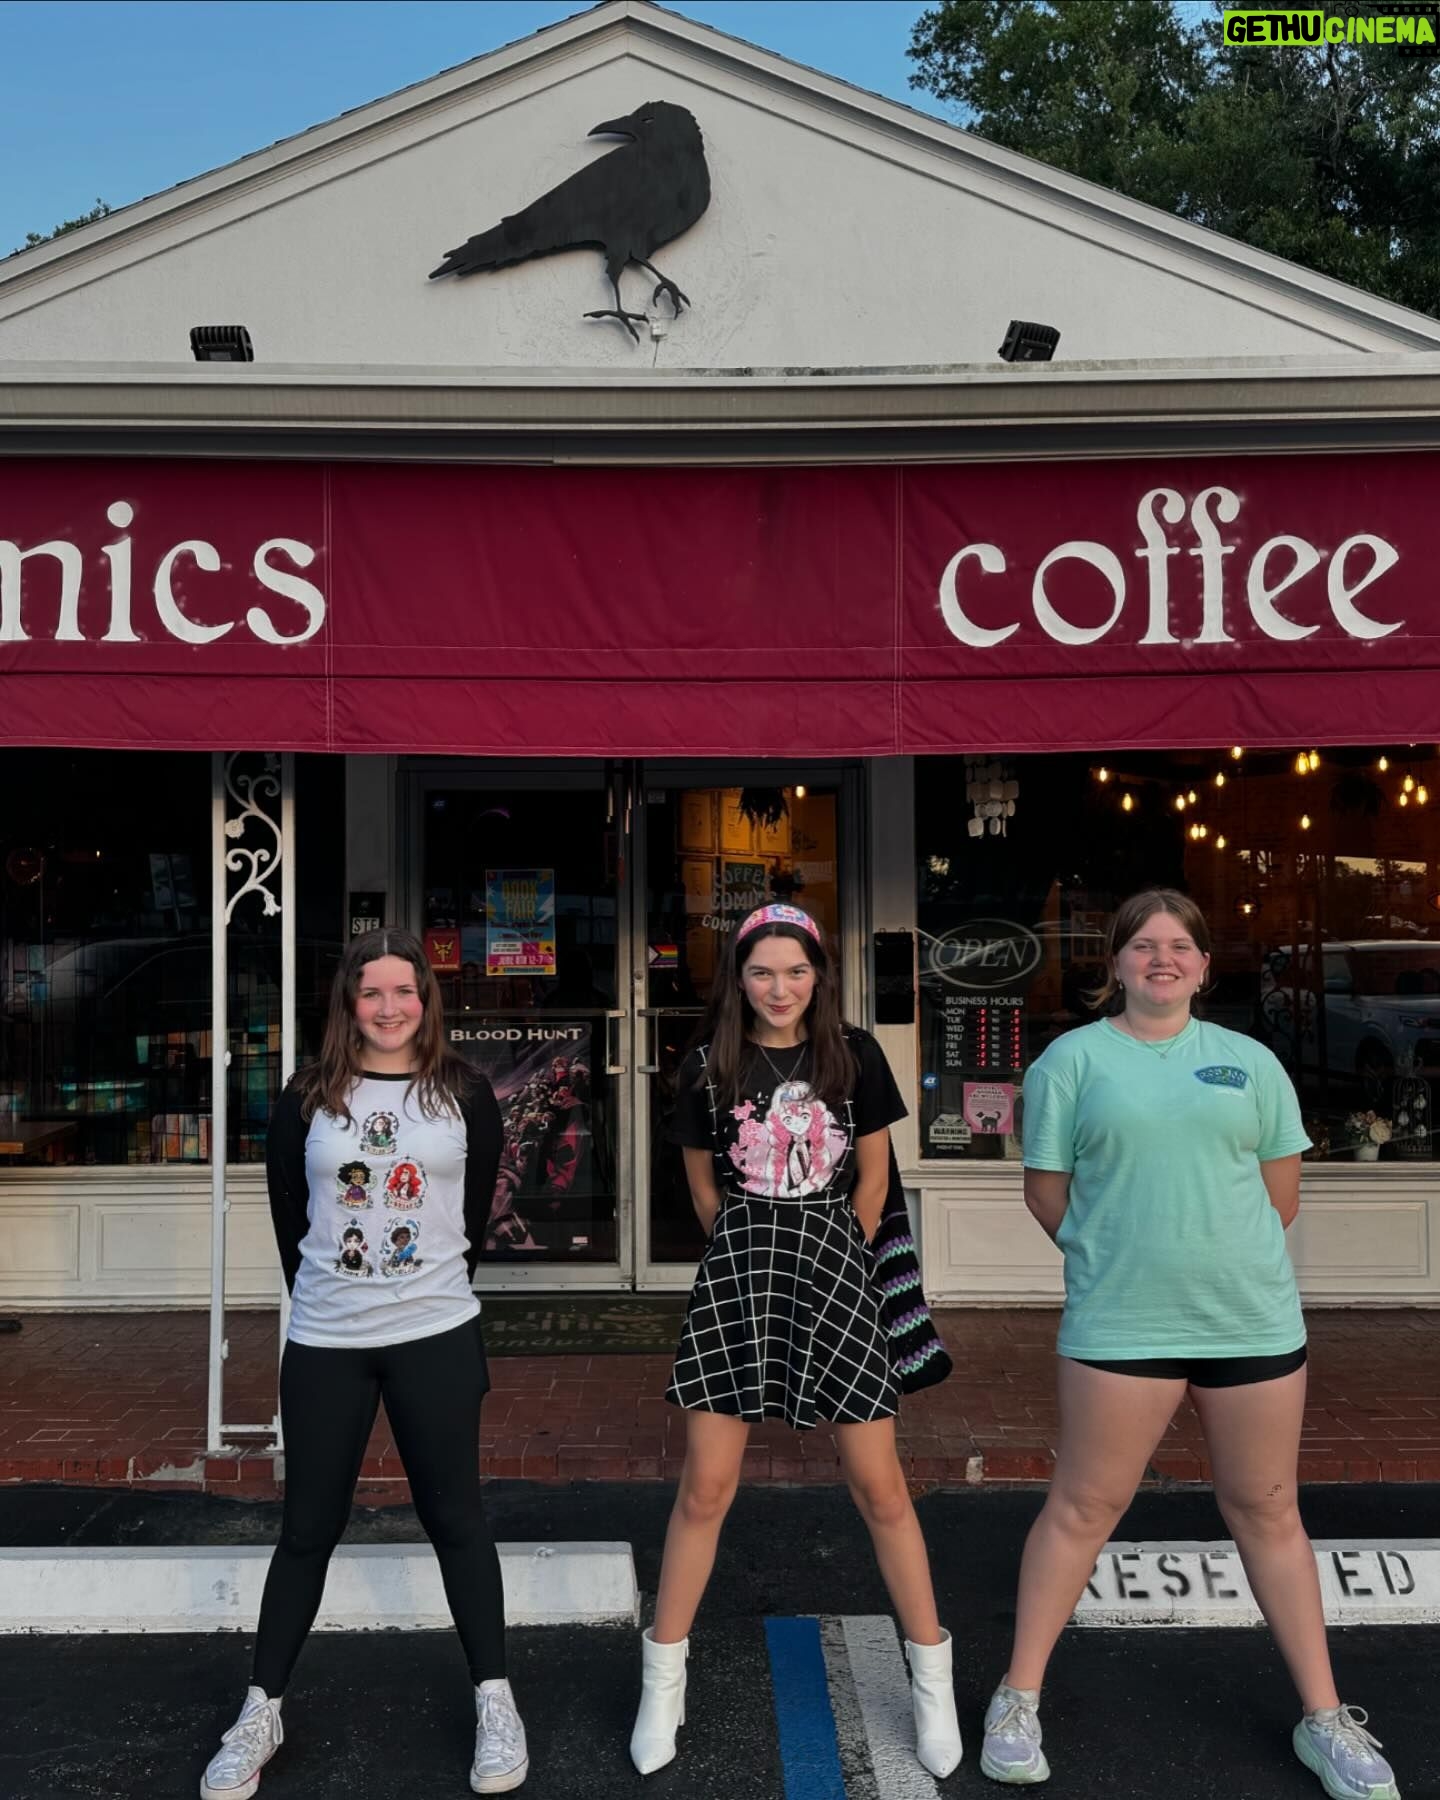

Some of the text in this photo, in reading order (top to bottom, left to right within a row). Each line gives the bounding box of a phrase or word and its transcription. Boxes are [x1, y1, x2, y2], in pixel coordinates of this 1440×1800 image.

[938, 486, 1405, 648] coffee
[503, 880, 538, 899] BOOK
[506, 901, 536, 920] FAIR
[935, 938, 1032, 968] OPEN
[945, 996, 1024, 1006] BUSINESS HOURS
[450, 1028, 582, 1041] BLOOD HUNT
[945, 1050, 960, 1058] SAT
[945, 1059, 962, 1067] SUN
[1086, 1550, 1416, 1599] ESEED
